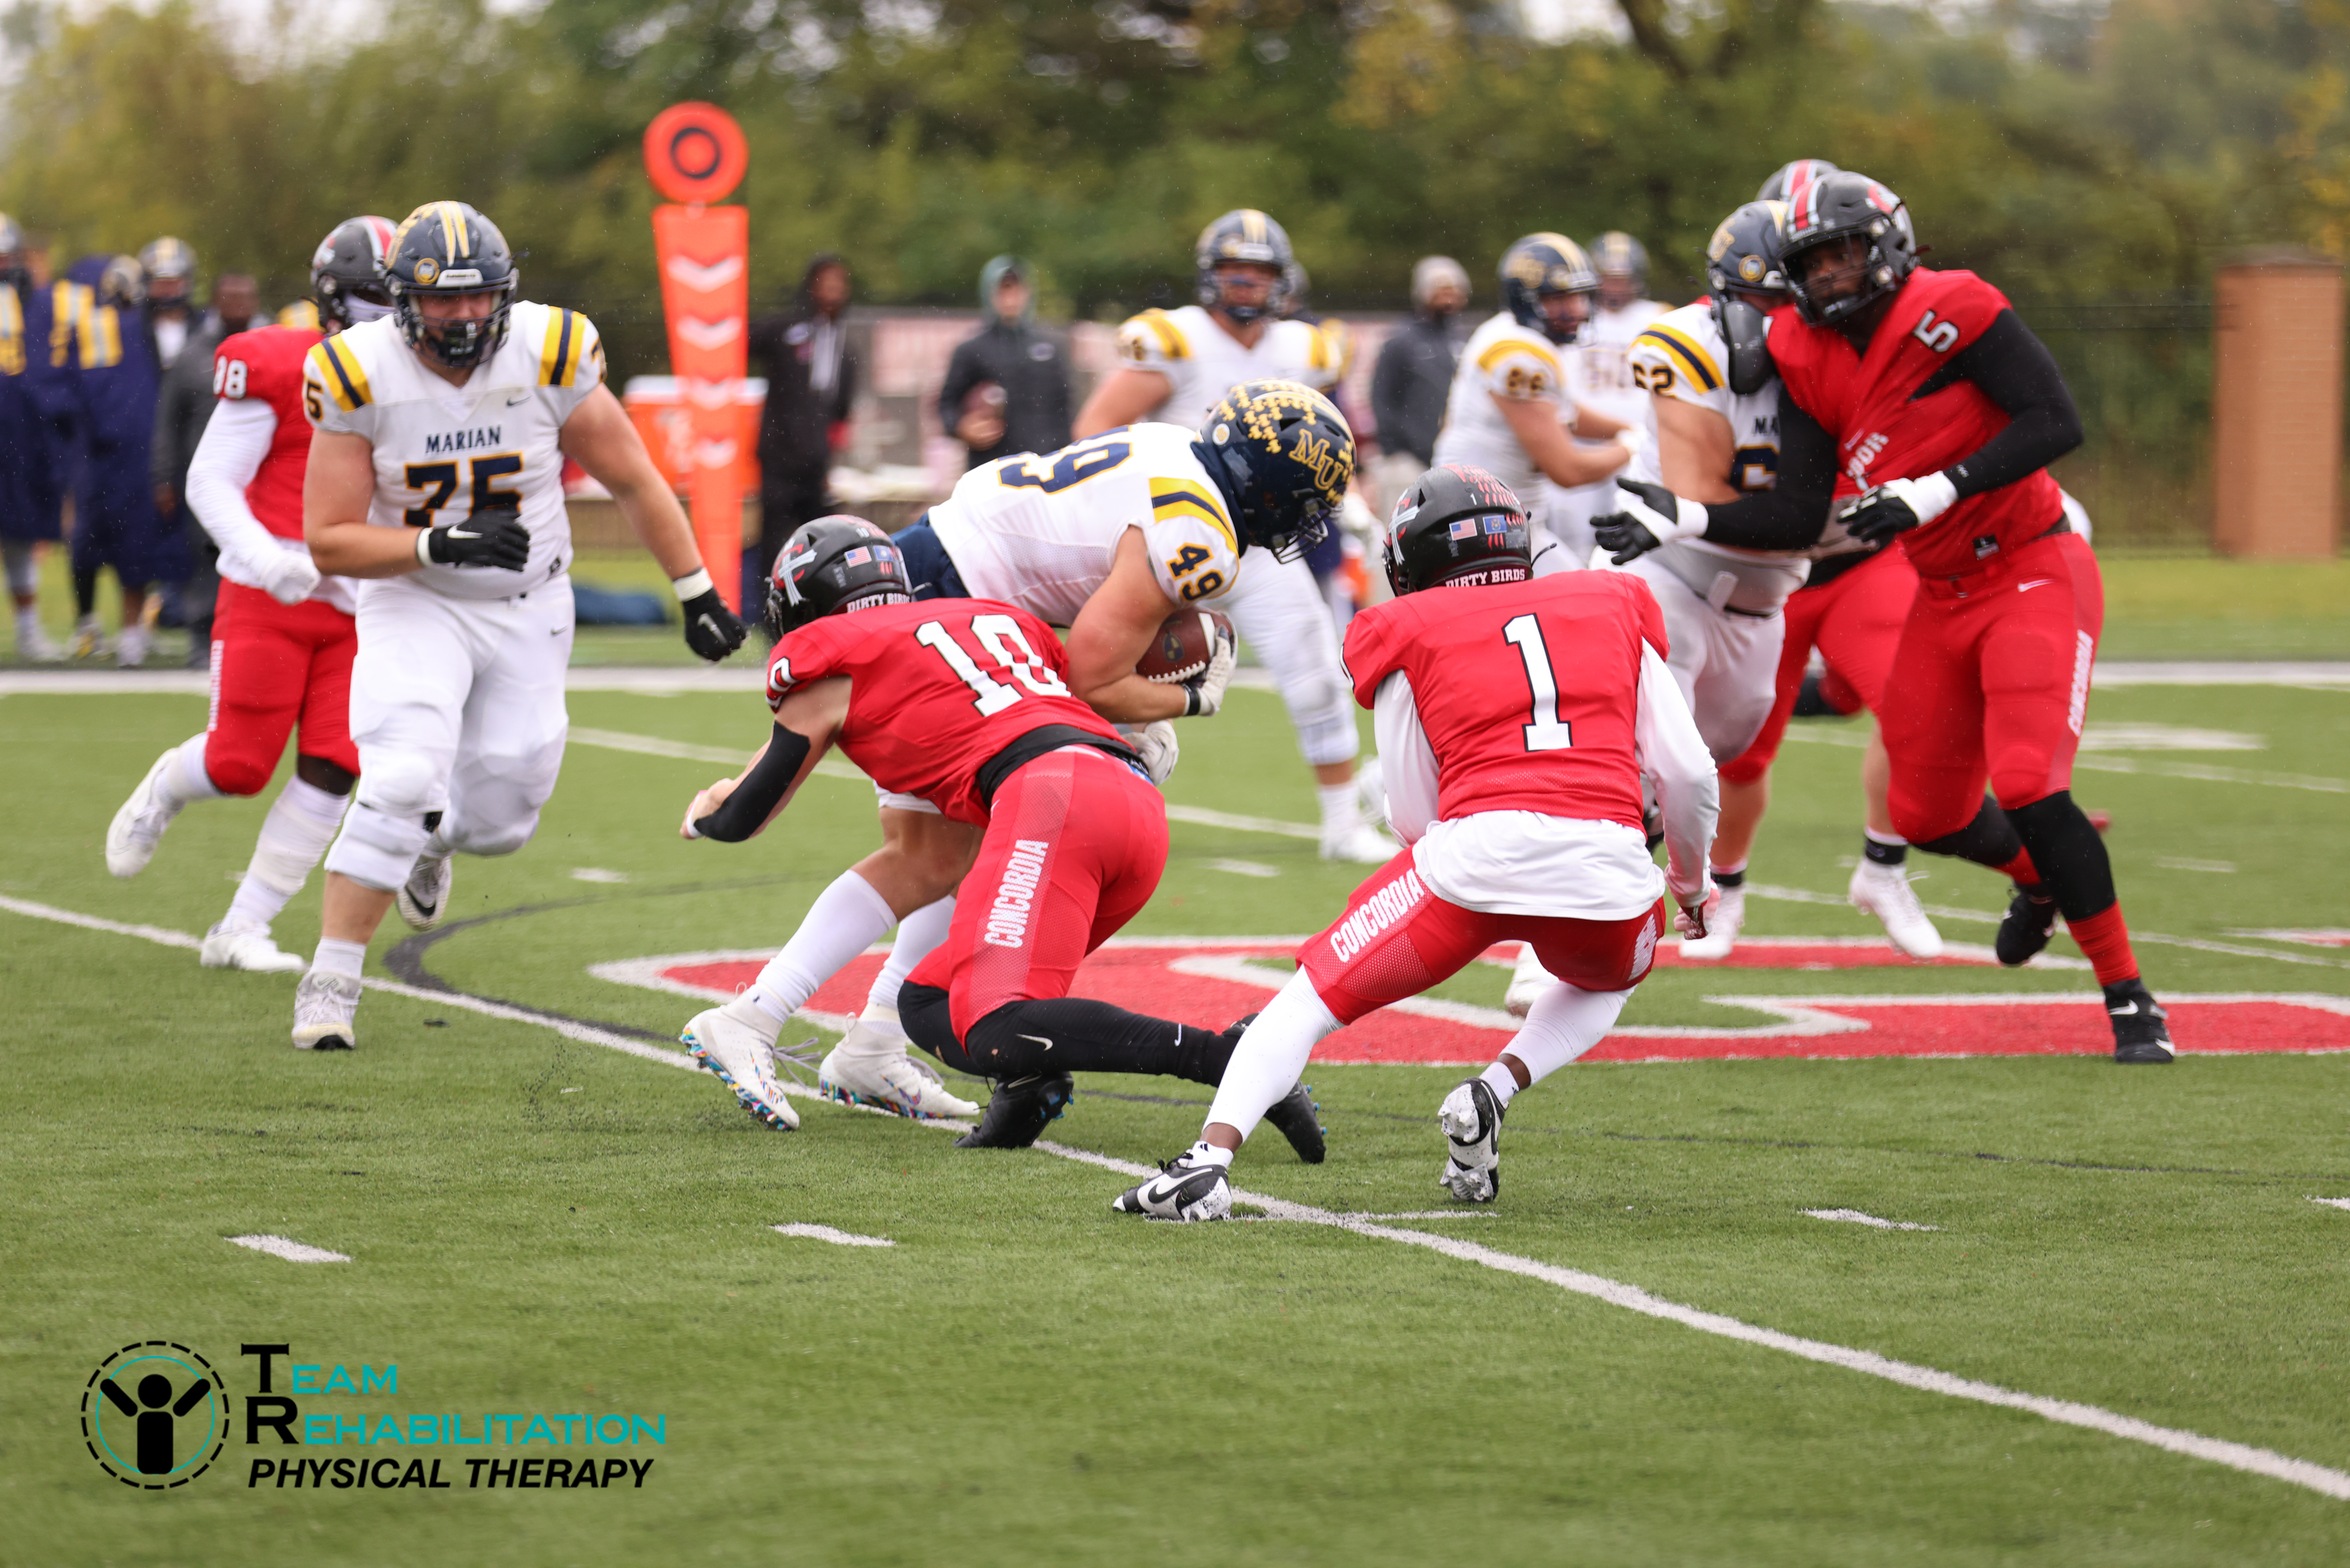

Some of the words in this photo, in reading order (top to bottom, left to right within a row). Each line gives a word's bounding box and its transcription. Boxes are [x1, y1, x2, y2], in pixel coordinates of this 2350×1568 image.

[1914, 309, 1959, 352] 5
[425, 425, 502, 453] MARIAN
[1289, 428, 1345, 491] MU
[1166, 542, 1225, 602] 49
[1446, 572, 1488, 588] DIRTY
[1491, 568, 1526, 582] BIRDS
[846, 593, 885, 613] DIRTY
[913, 614, 1072, 717] 10
[1501, 612, 1573, 752] 1
[984, 839, 1049, 948] CONCORDIA
[1330, 867, 1425, 963] CONCORDIA
